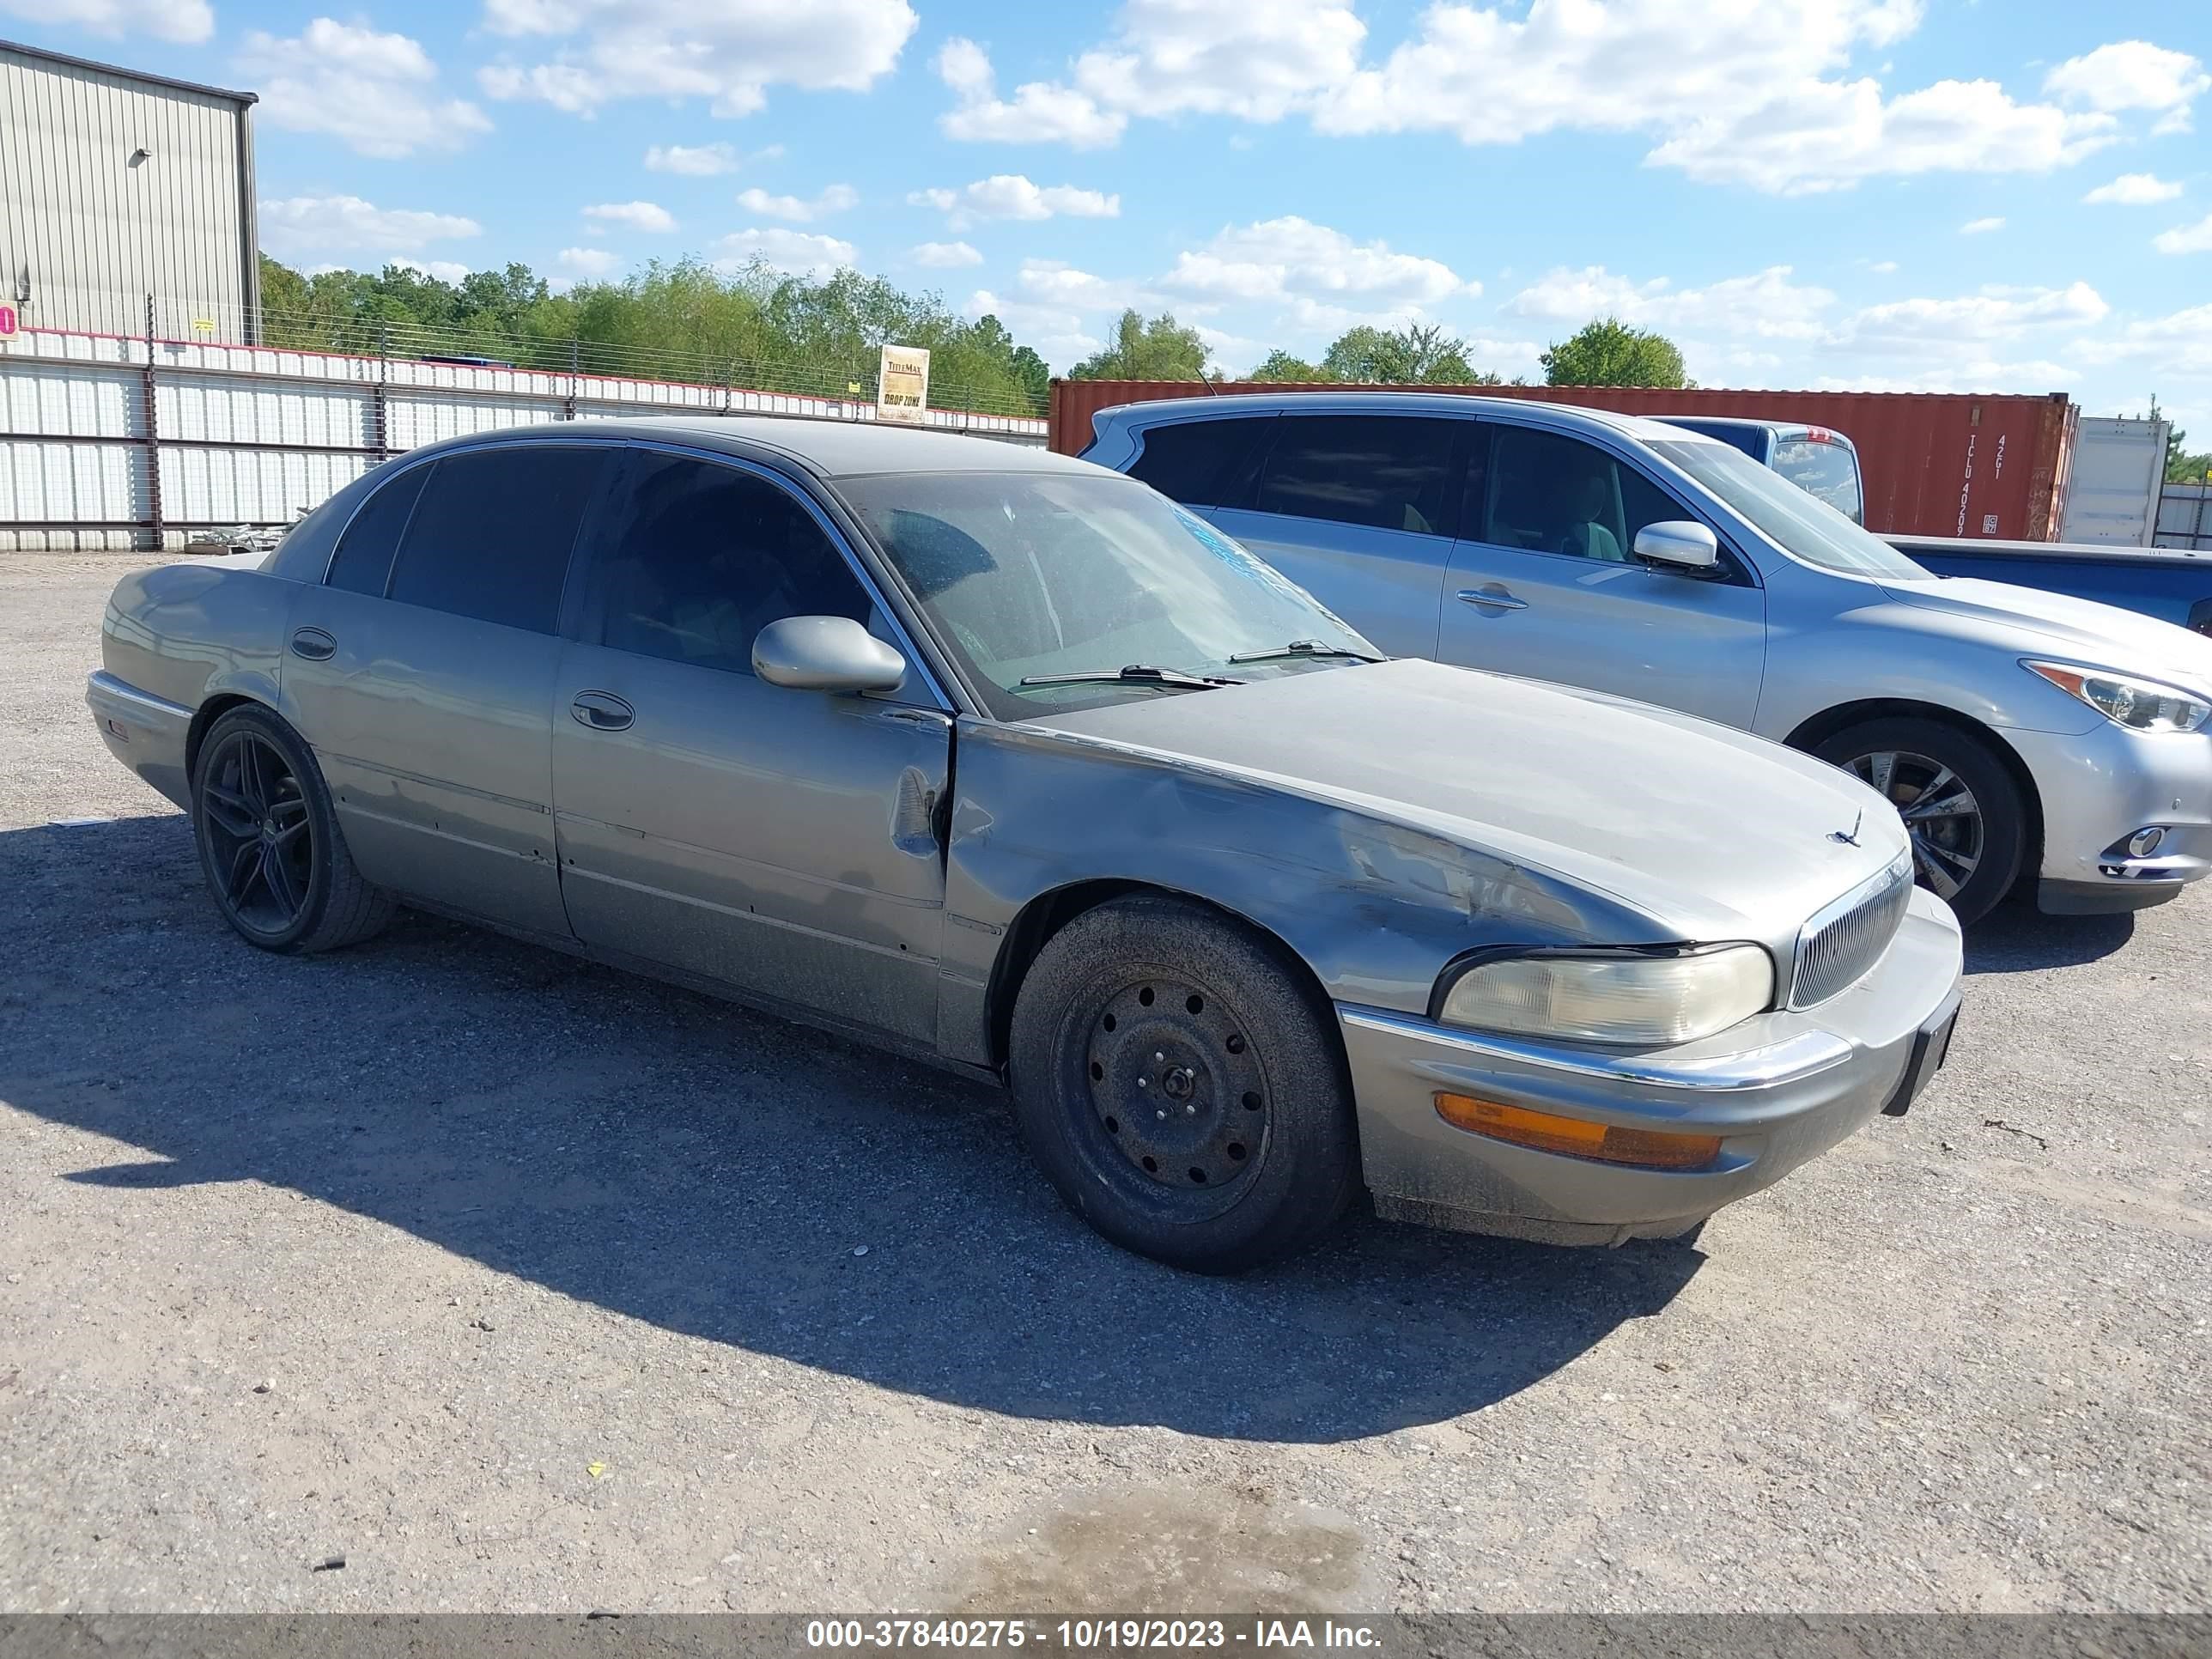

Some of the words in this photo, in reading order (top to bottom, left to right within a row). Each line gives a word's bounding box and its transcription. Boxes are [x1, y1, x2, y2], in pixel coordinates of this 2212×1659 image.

[884, 393, 903, 406] DROP
[903, 395, 921, 408] ZONE
[1965, 434, 1976, 479] TCLU
